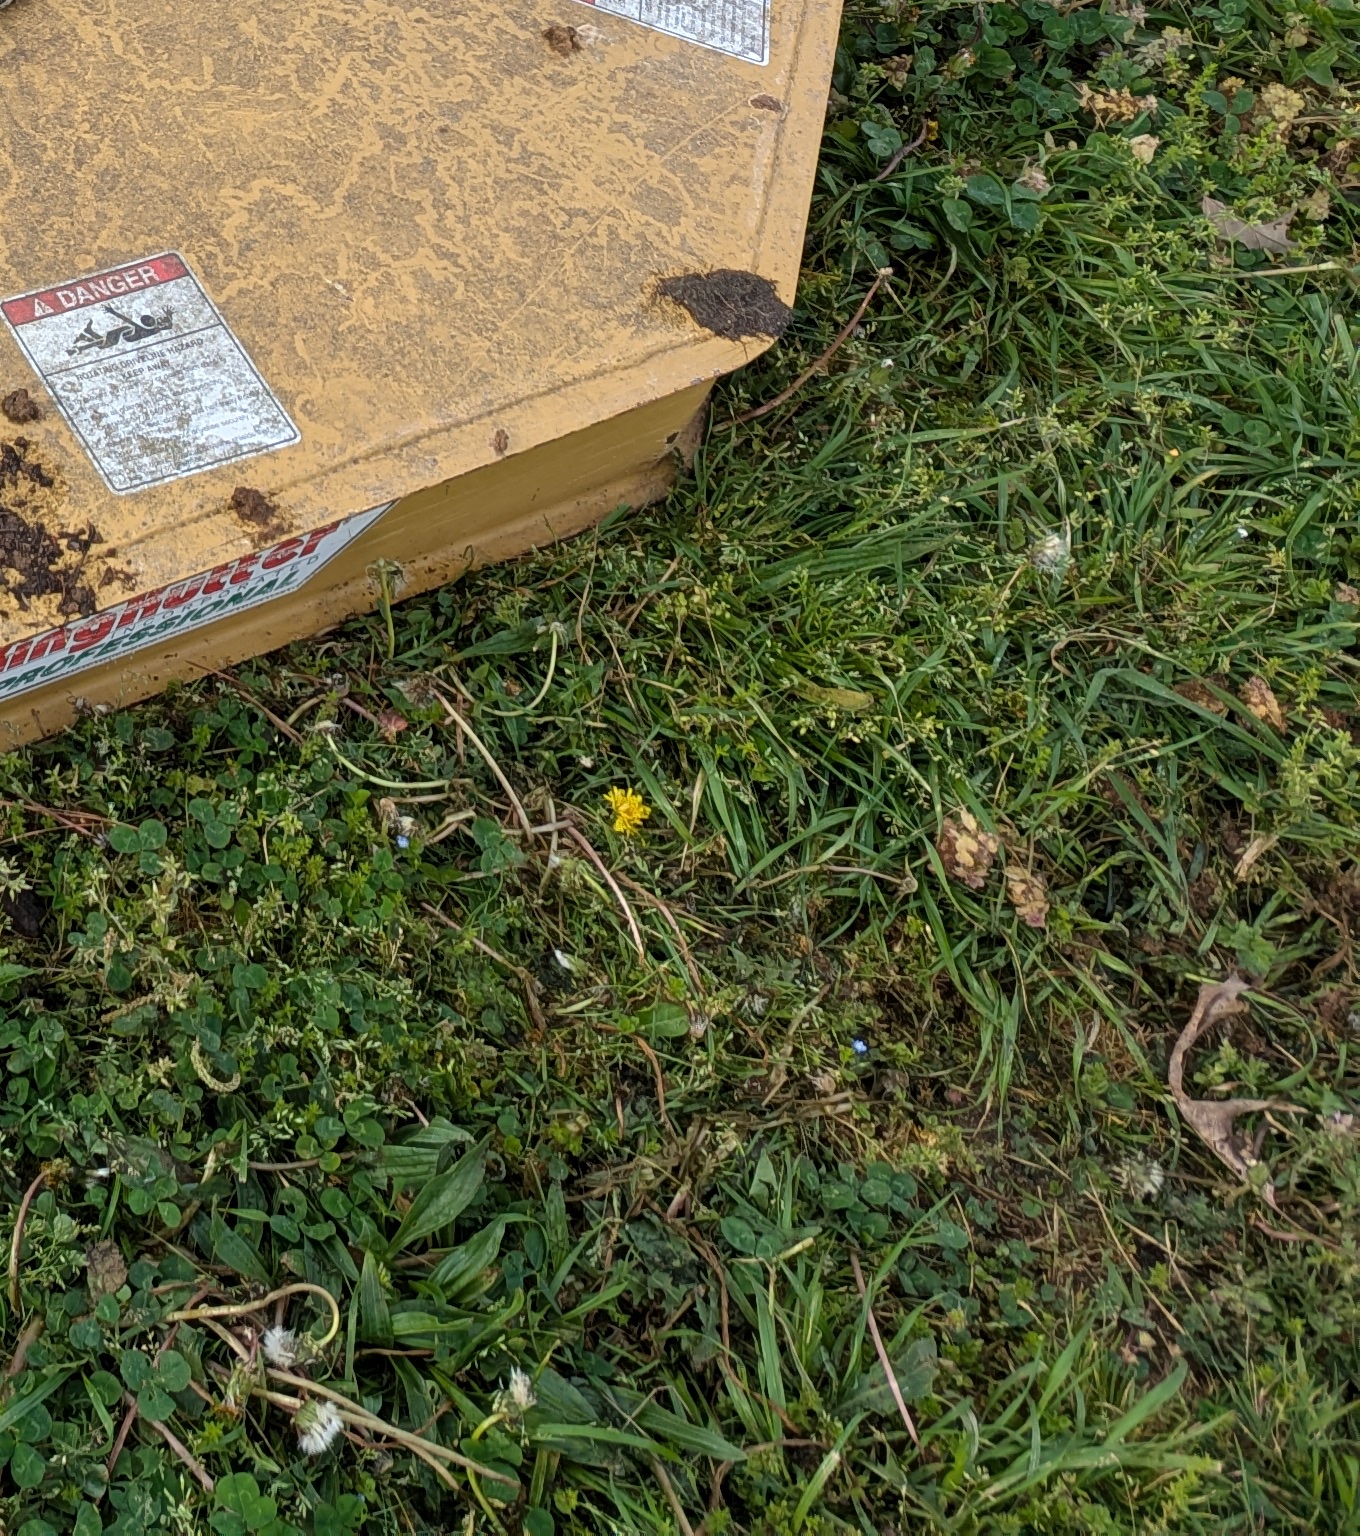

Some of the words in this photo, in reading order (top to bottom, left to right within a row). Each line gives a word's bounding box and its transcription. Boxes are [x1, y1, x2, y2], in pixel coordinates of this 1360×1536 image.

[55, 264, 161, 309] DANGER
[75, 363, 119, 381] ROTATING
[118, 349, 167, 368] DRIVELINE
[166, 337, 206, 354] HAZARD
[120, 366, 146, 380] KEEP
[145, 359, 173, 373] AWAY
